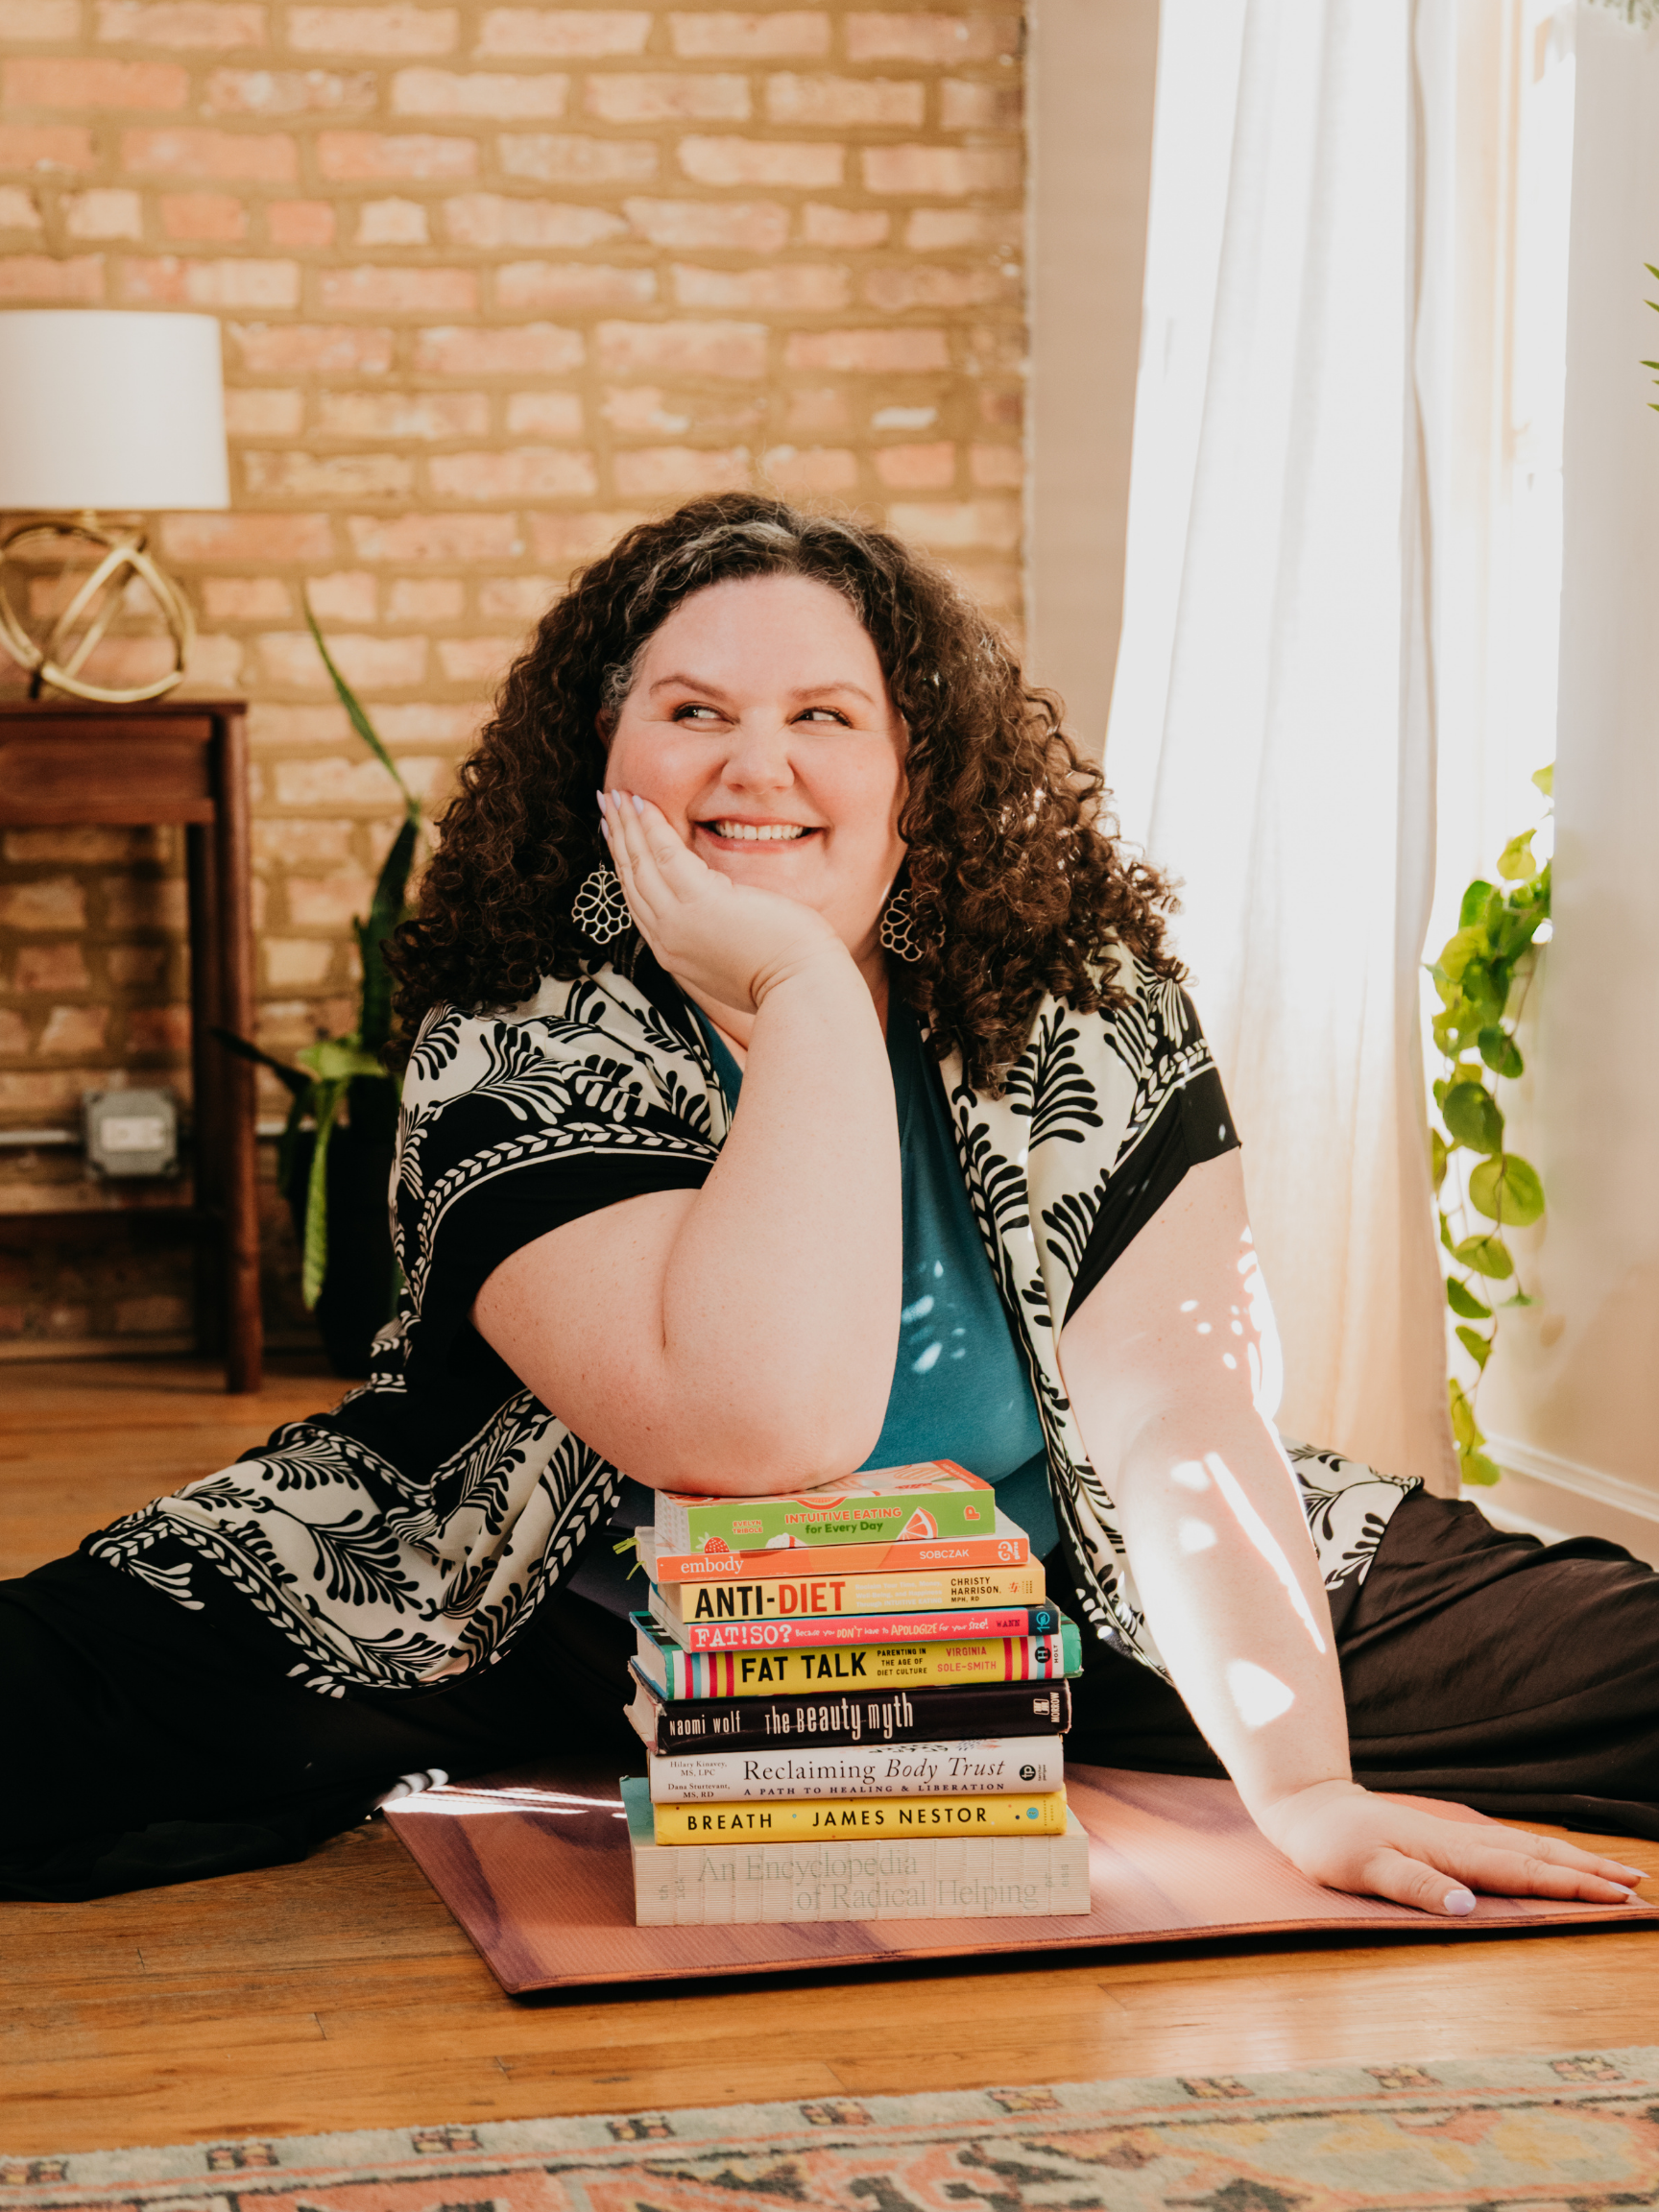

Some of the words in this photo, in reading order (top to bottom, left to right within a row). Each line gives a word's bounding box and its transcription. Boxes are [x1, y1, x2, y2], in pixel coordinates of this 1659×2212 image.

[785, 1510, 851, 1524] INTUITIVE
[854, 1507, 902, 1520] EATING
[805, 1524, 823, 1534] for
[825, 1523, 857, 1535] Every
[860, 1522, 883, 1532] Day
[919, 1549, 970, 1560] SOBCZAK
[681, 1556, 744, 1574] embody
[950, 1576, 991, 1586] CHRISTY
[950, 1586, 1001, 1596] HARRISON,
[694, 1581, 846, 1619] ANTI-DIET
[837, 1625, 862, 1638] DON'T
[891, 1623, 937, 1636] APOLOGIZE
[939, 1623, 949, 1631] for
[951, 1623, 968, 1632] your
[968, 1618, 989, 1630] size!
[996, 1620, 1021, 1628] WANN
[695, 1624, 792, 1647] FAT!SO?
[877, 1648, 918, 1657] PARENTING
[946, 1647, 987, 1657] VIRGINIA
[741, 1656, 788, 1683] FAT
[801, 1651, 867, 1679] TALK
[895, 1667, 927, 1675] CULTURE
[937, 1661, 997, 1672] SOLE-SMITH
[1051, 1692, 1060, 1722] MORROW
[764, 1705, 790, 1735] The
[797, 1697, 861, 1741] Beauty
[670, 1760, 694, 1768] Hilary
[744, 1758, 876, 1785] Reclaiming
[884, 1759, 938, 1783] Body
[948, 1757, 1005, 1776] Trust
[689, 1783, 731, 1791] Sturtevant,
[760, 1787, 795, 1795] PATH
[830, 1785, 893, 1793] HEALING
[918, 1783, 1004, 1791] LIBERATION
[687, 1813, 773, 1831] BREATH
[812, 1810, 884, 1827] JAMES
[900, 1807, 987, 1824] NESTOR
[697, 1857, 736, 1882] An
[746, 1848, 918, 1887] Encyclopedia
[796, 1883, 826, 1911] of
[832, 1880, 926, 1910] Radical
[938, 1877, 1039, 1911] Helping
